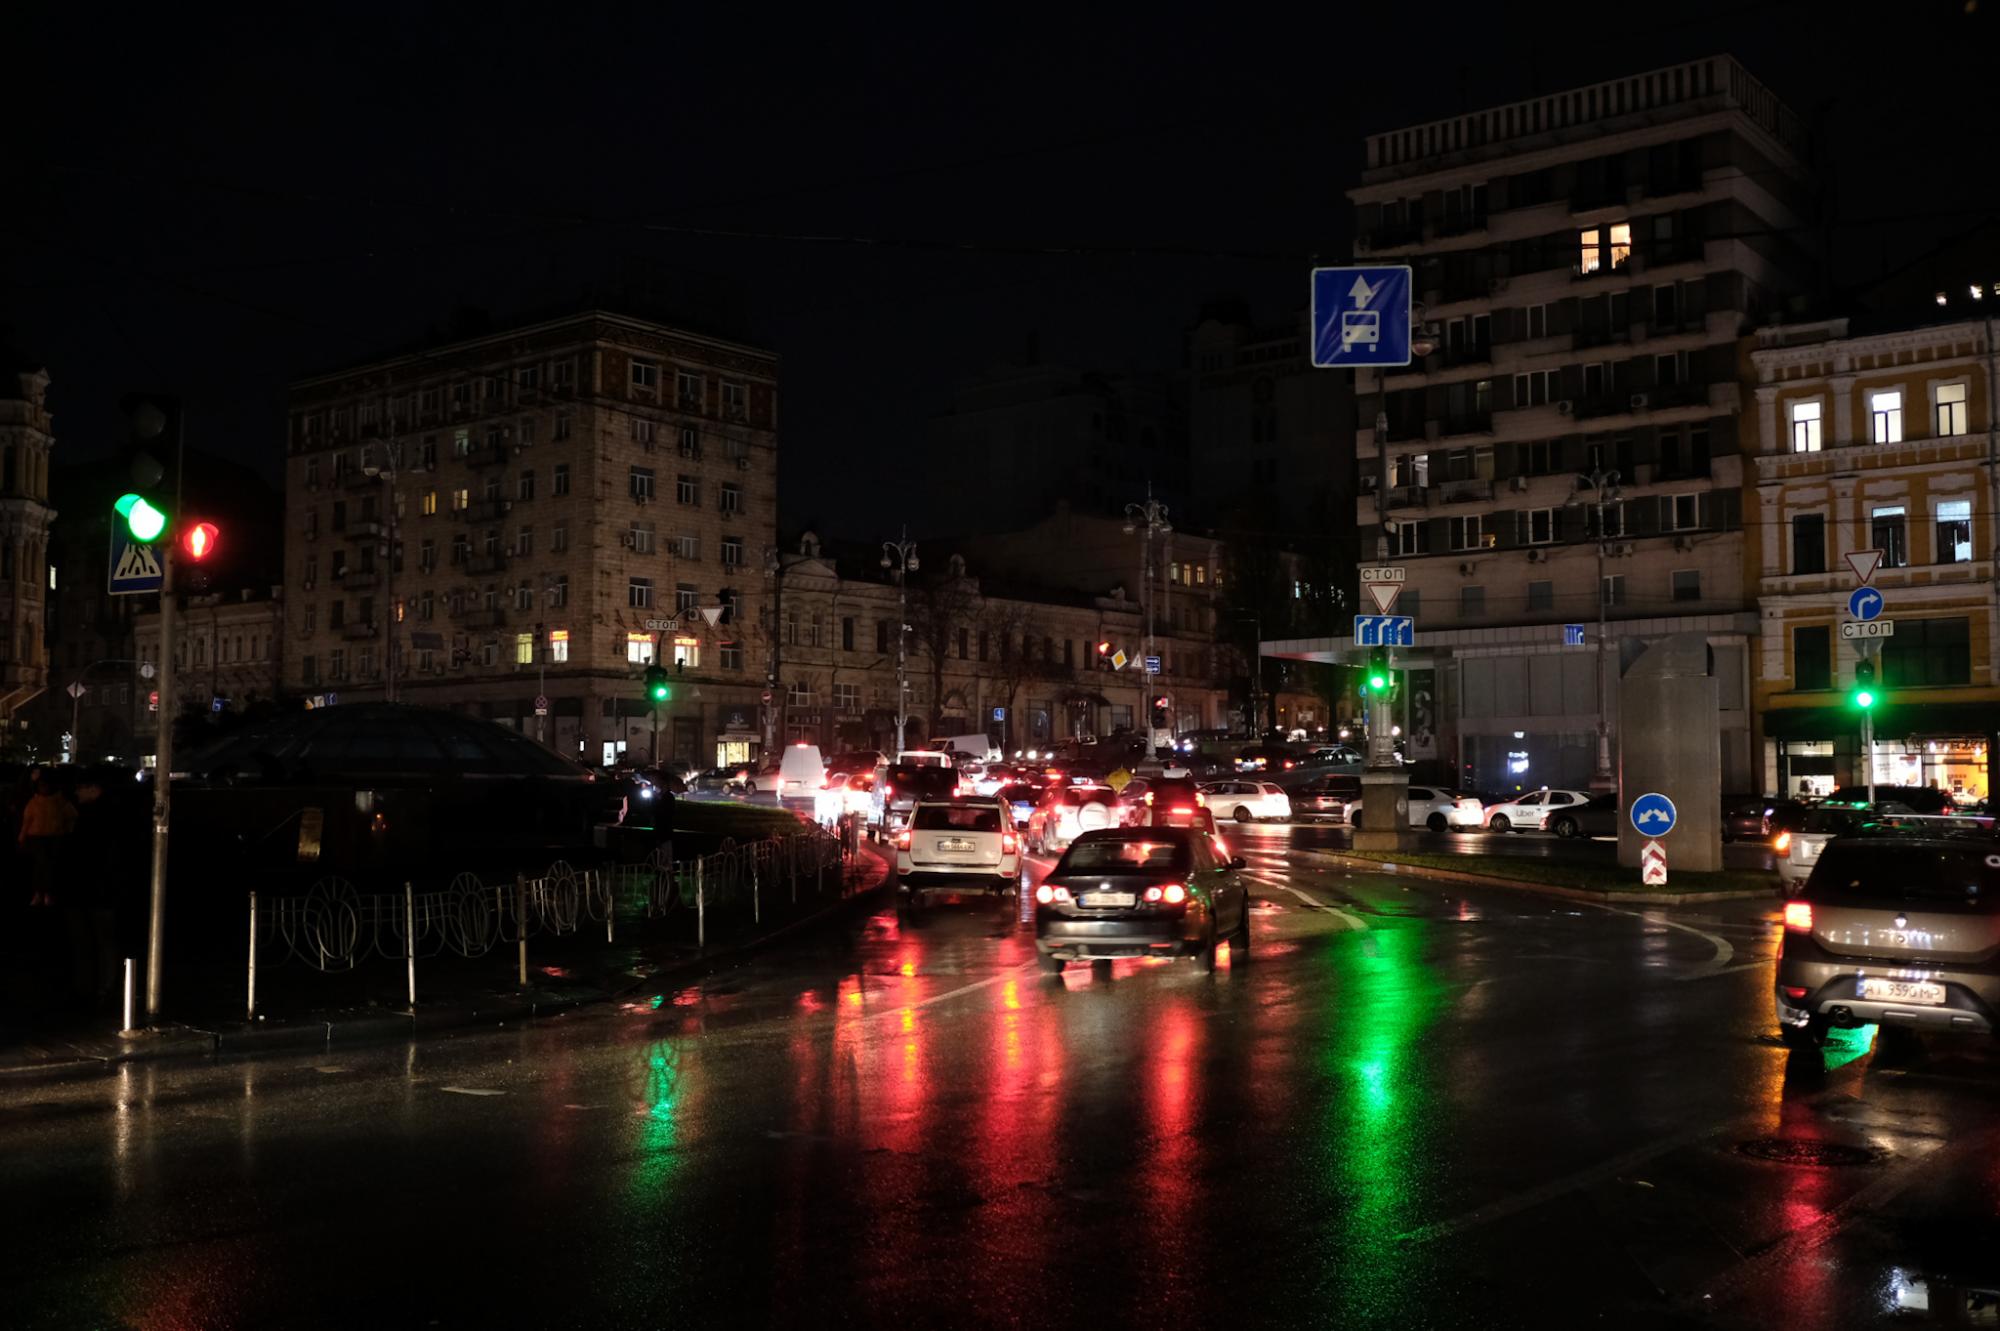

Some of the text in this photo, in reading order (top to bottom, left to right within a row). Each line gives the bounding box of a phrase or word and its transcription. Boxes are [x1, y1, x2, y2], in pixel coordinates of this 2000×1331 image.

[1363, 569, 1403, 581] СТОП
[647, 620, 677, 629] СТОП
[1843, 622, 1892, 637] СТОП
[1516, 808, 1534, 817] Uber
